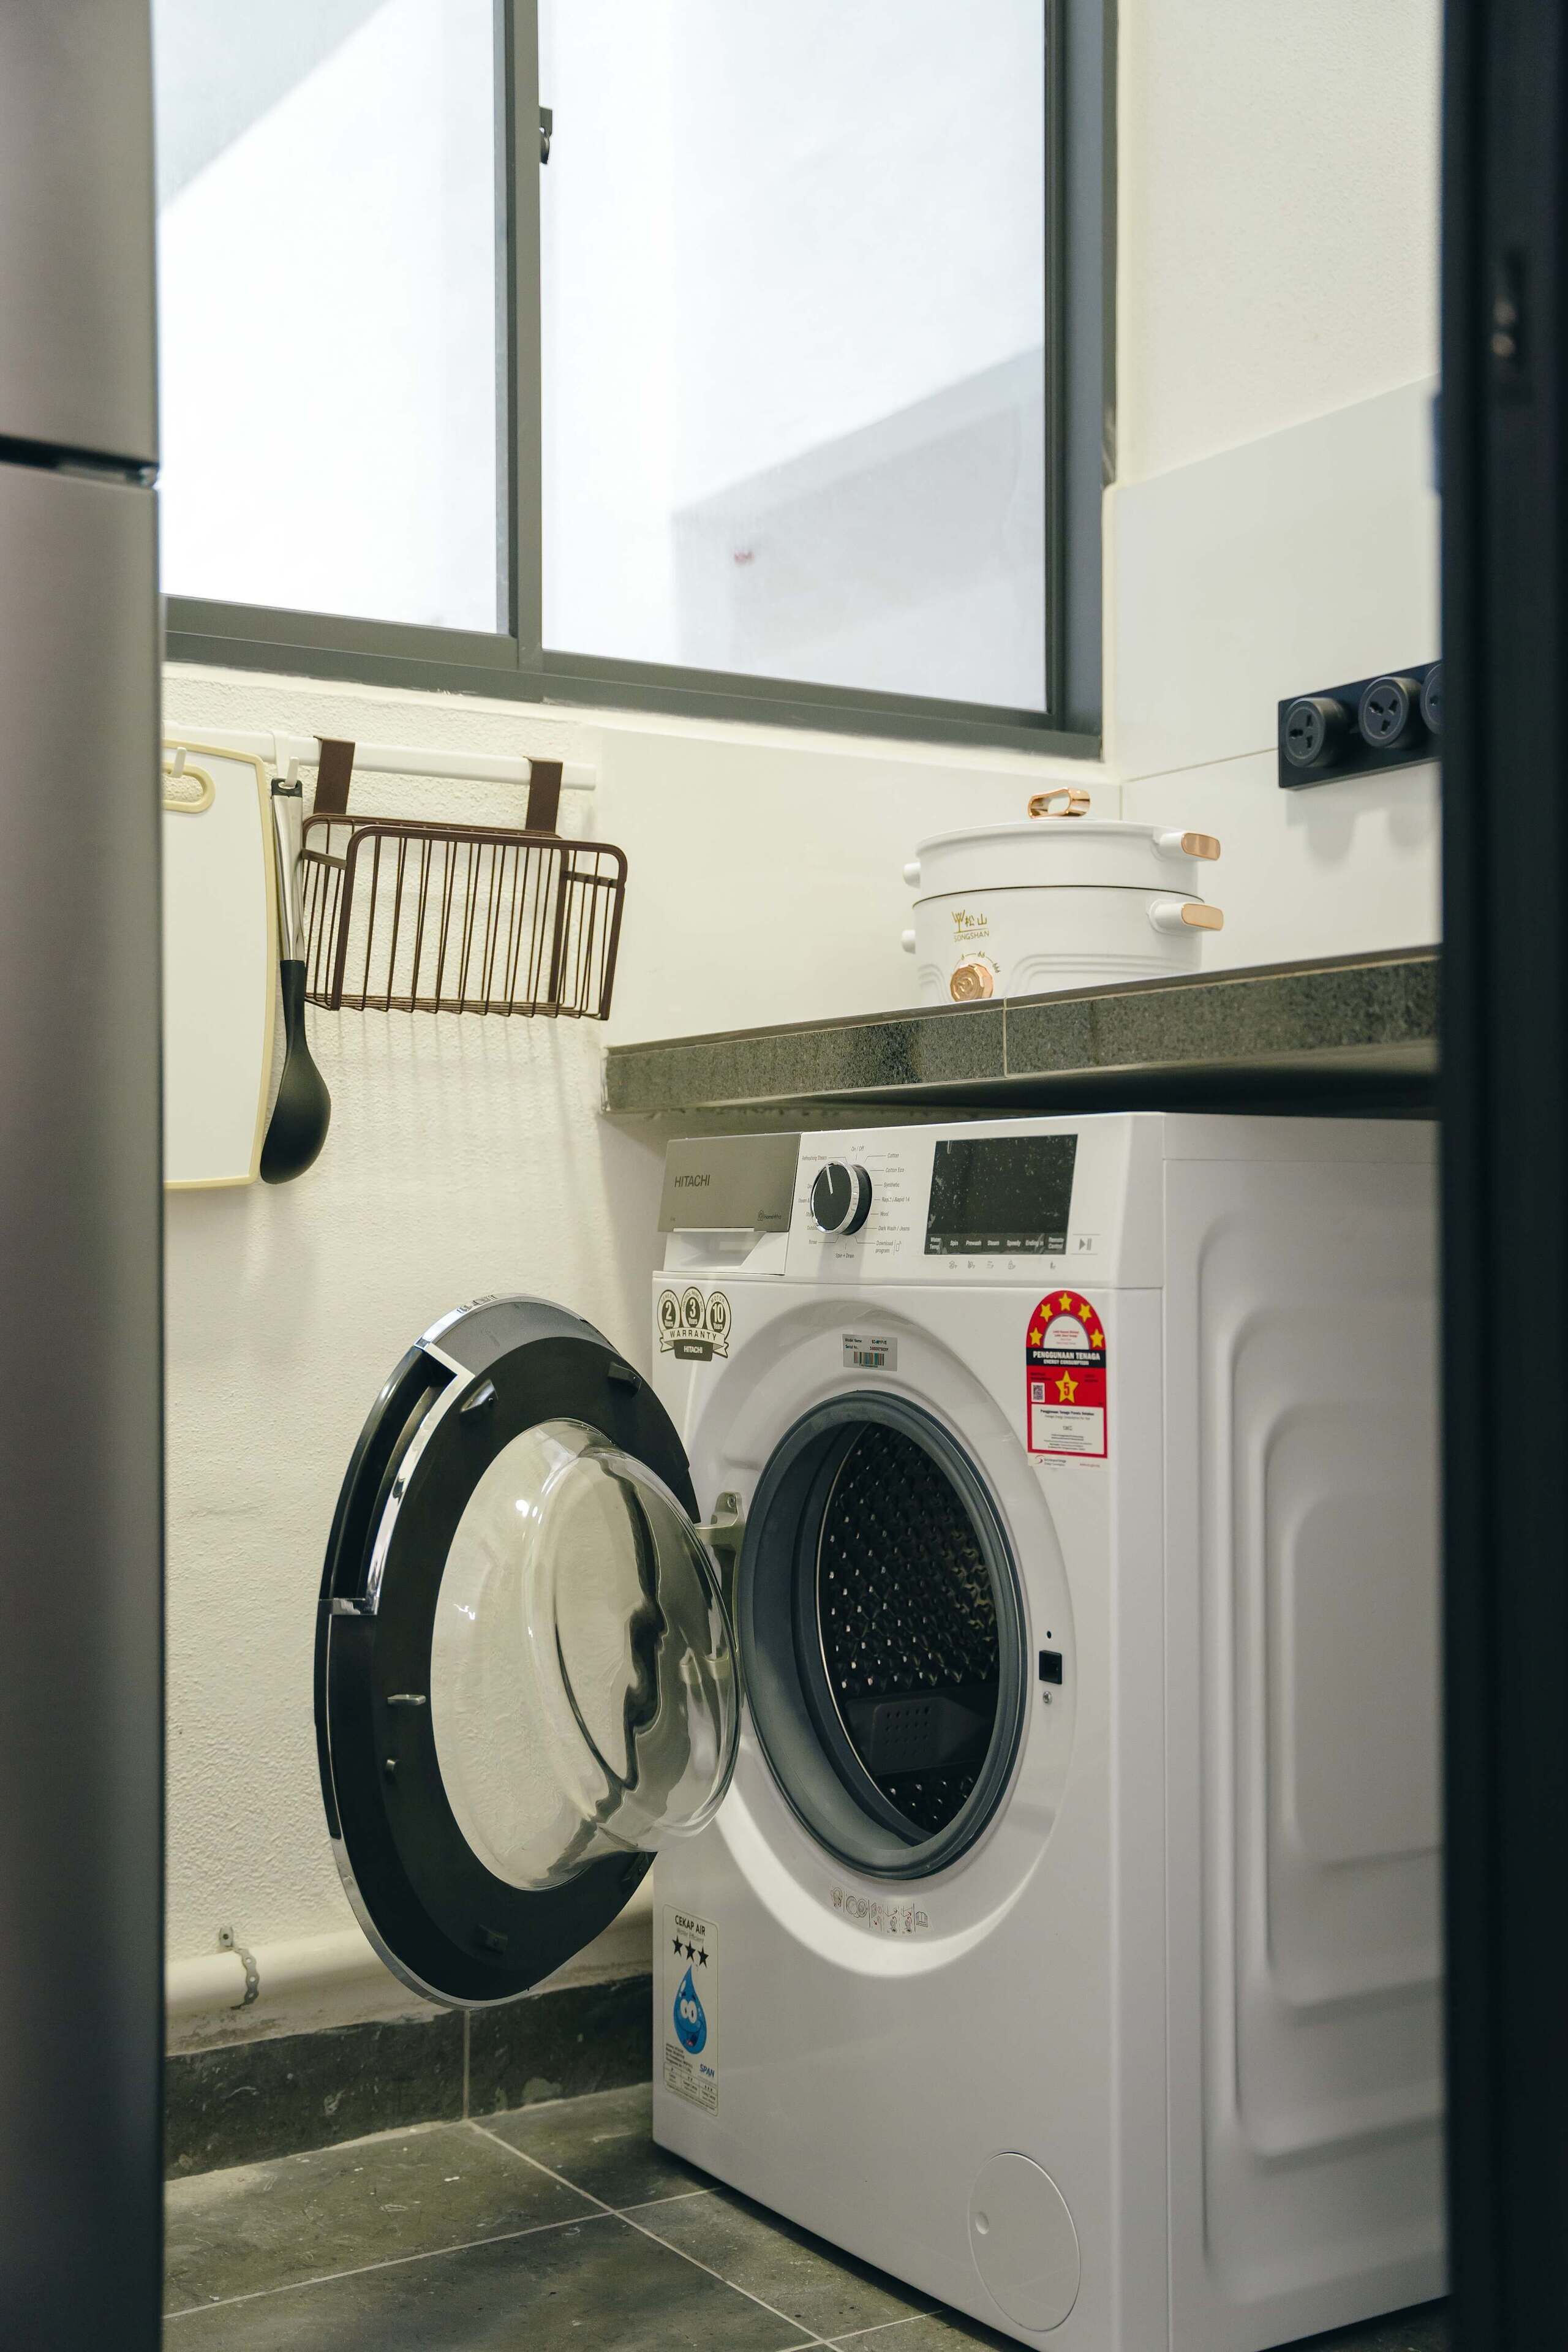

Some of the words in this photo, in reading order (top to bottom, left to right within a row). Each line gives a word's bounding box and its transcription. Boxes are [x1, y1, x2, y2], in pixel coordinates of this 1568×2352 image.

[954, 930, 989, 942] SONGSHAN
[674, 1174, 710, 1187] HITACHI
[710, 1295, 725, 1304] MOTOR
[665, 1301, 672, 1320] 2
[689, 1298, 696, 1318] 3
[712, 1303, 724, 1323] 10
[669, 1329, 717, 1341] WARRANTY
[1033, 1351, 1074, 1359] PENGGUNAAN
[1076, 1352, 1101, 1360] TENAGA
[1063, 1382, 1069, 1396] 5
[675, 1915, 695, 1931] CEKAP
[695, 1924, 706, 1936] AIR
[699, 2063, 715, 2078] SPAN
